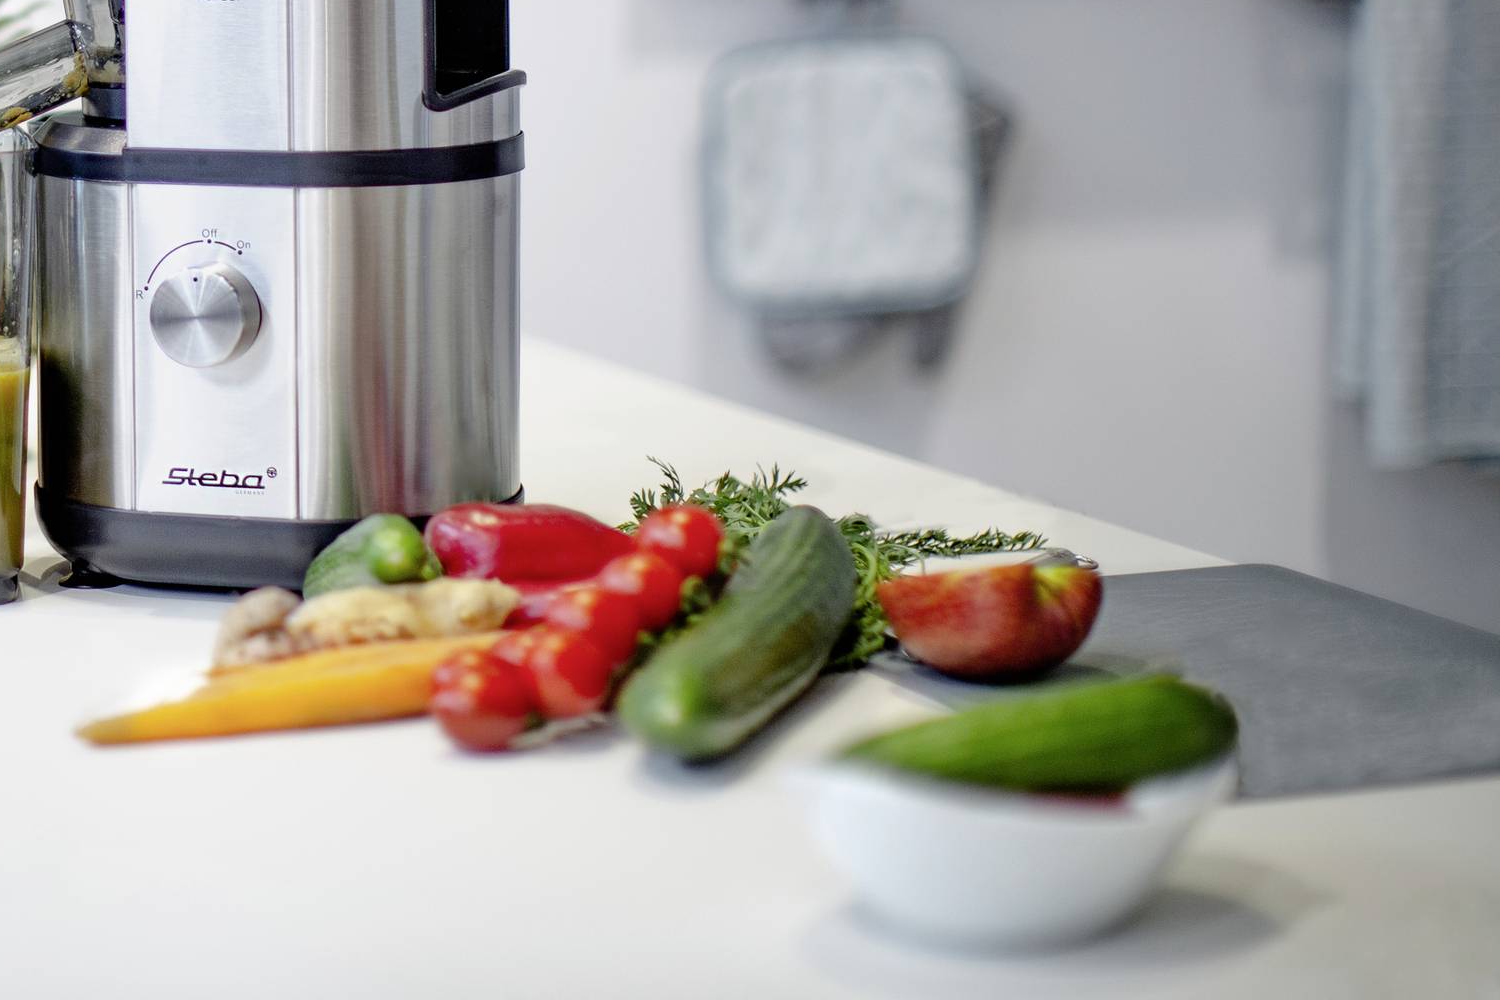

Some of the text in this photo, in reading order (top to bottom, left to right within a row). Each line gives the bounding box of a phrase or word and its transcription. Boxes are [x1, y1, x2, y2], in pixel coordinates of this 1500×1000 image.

[201, 228, 218, 238] Off
[236, 240, 251, 249] On
[135, 290, 144, 300] R
[162, 467, 265, 489] Steba
